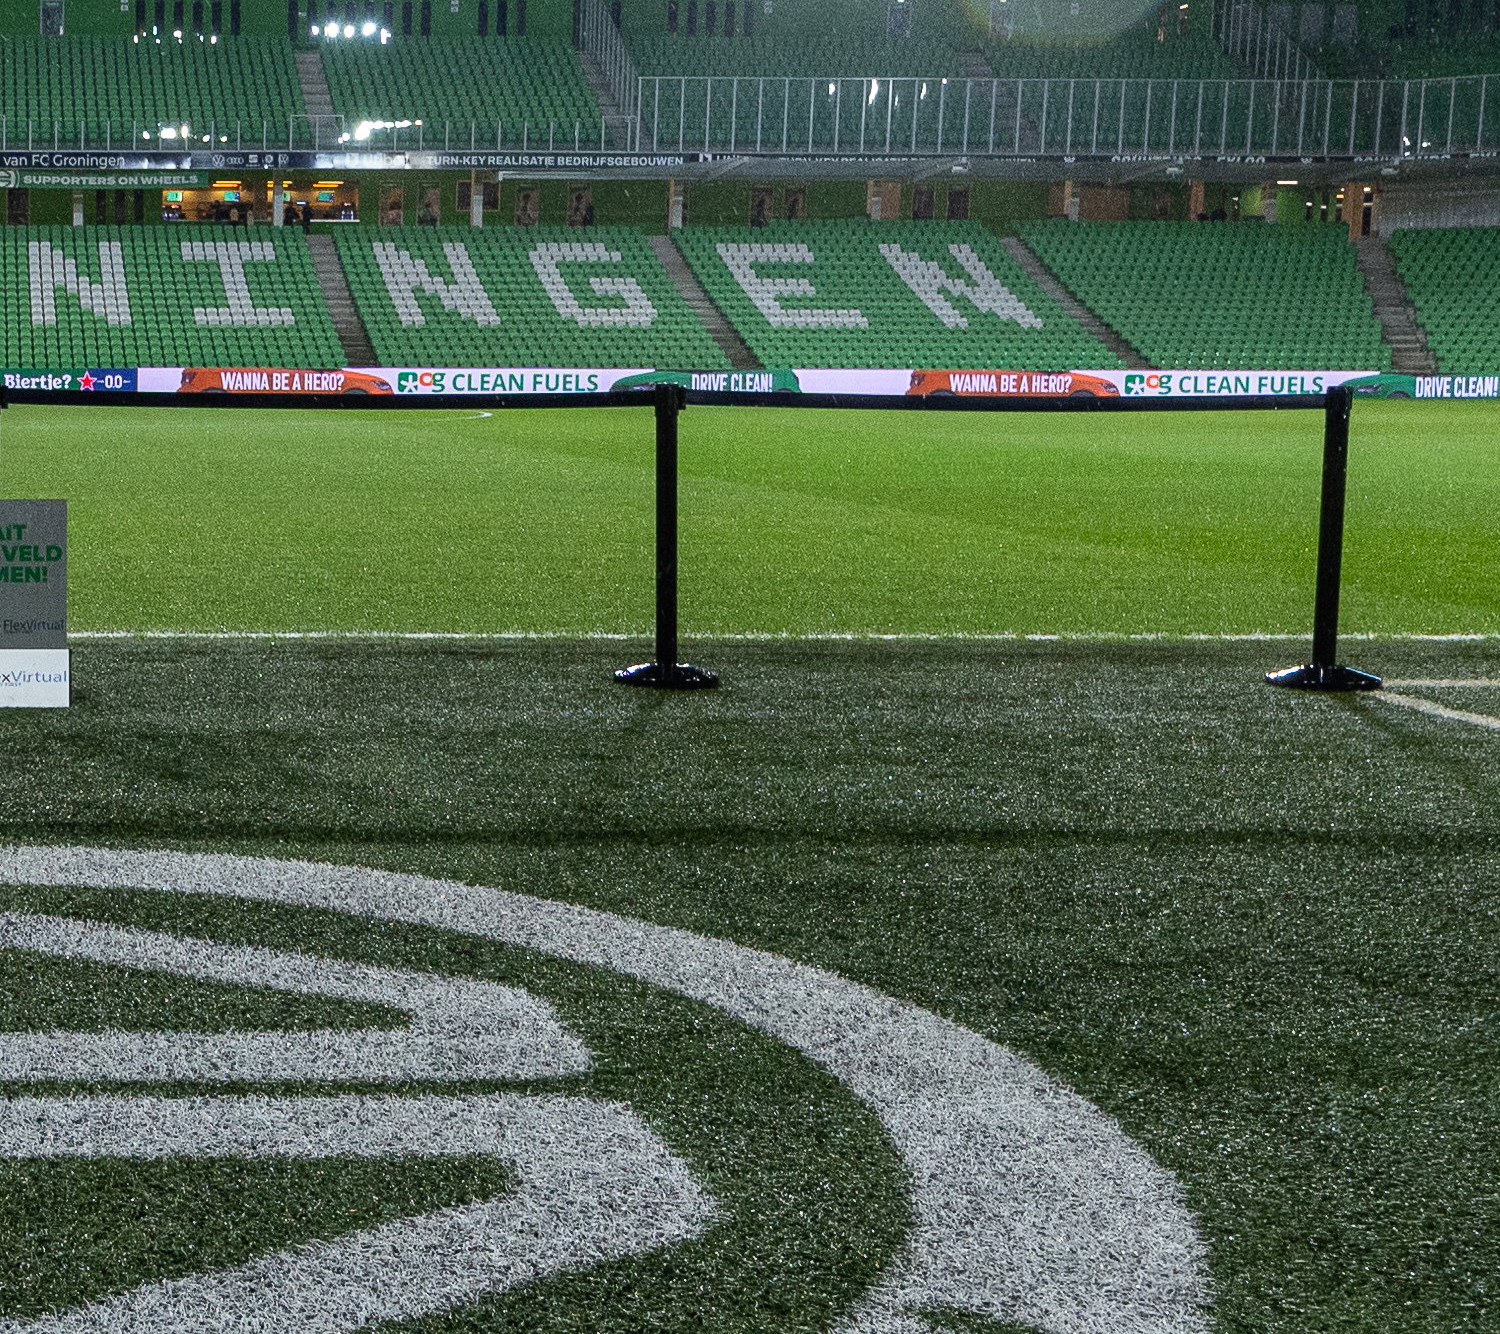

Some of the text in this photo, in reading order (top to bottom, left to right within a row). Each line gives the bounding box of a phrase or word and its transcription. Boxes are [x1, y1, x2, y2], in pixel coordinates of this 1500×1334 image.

[3, 156, 28, 166] van
[32, 154, 49, 166] FC
[53, 154, 125, 169] Groningen
[488, 155, 555, 166] REALISATIE
[556, 155, 684, 167] BEDRIJFSGEBOUWEN
[23, 174, 199, 186] SUPPORTERS ON WHEELS
[4, 373, 73, 390] Biertje?
[220, 372, 345, 391] WANNA BE A HERO?
[452, 373, 525, 392] CLEAN
[532, 373, 599, 391] FUELS
[691, 373, 774, 393] DRIVE CLEAN!
[949, 374, 1073, 394] WANNA BE A HERO?
[1179, 375, 1250, 394] CLEAN
[1258, 375, 1324, 394] FUELS
[1415, 376, 1500, 399] DRIVE CLEAN!
[2, 545, 63, 562] VELD
[3, 618, 65, 632] FlexVirtual
